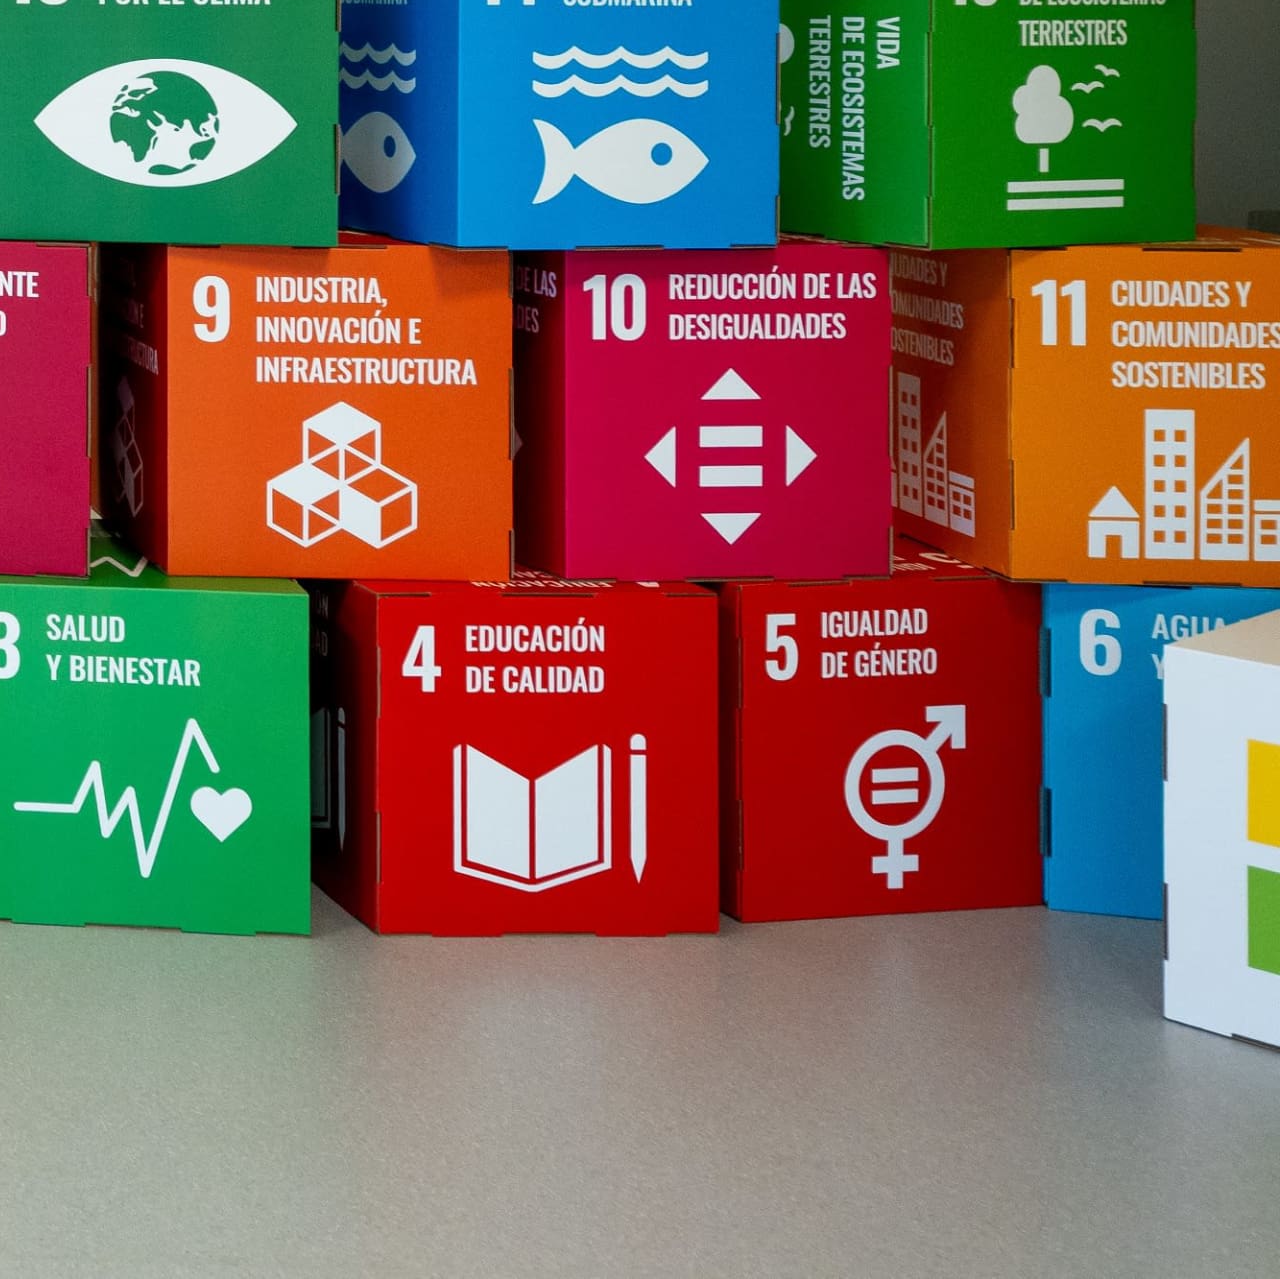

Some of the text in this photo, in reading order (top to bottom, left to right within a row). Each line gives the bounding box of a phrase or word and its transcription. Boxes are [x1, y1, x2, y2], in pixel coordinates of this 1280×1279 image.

[877, 17, 900, 69] VIDA
[1018, 20, 1127, 46] TERRESTRES
[809, 15, 831, 148] TERRESTRES
[842, 17, 865, 200] DE ECOSISTEMAS
[534, 269, 557, 298] LAS
[890, 252, 948, 287] IUDADES Y
[193, 276, 230, 342] 9
[256, 275, 388, 308] INDUSTRIA,
[583, 265, 876, 341] 10 REDUCCIÓN DE LAS
[891, 290, 964, 329] OMUNIDADES
[1031, 280, 1251, 346] 11 CIUDADES Y
[256, 310, 421, 344] INNOVACIÓN E
[669, 313, 846, 340] DESIGUALDADES
[1111, 321, 1280, 348] COMUNIDADES
[891, 326, 955, 366] OSTENIBLES
[256, 357, 477, 385] INFRAESTRUCTURA
[1112, 361, 1265, 389] SOSTENIBLES
[46, 614, 125, 642] SALUD
[766, 608, 927, 680] 5 IGUALDAD
[1080, 609, 1121, 676] 6
[46, 654, 200, 686] Y BIENESTAR
[402, 617, 604, 692] 4 EDUCACIÓN
[822, 642, 937, 678] DE GÉNERO
[466, 666, 604, 693] DE CALIDAD
